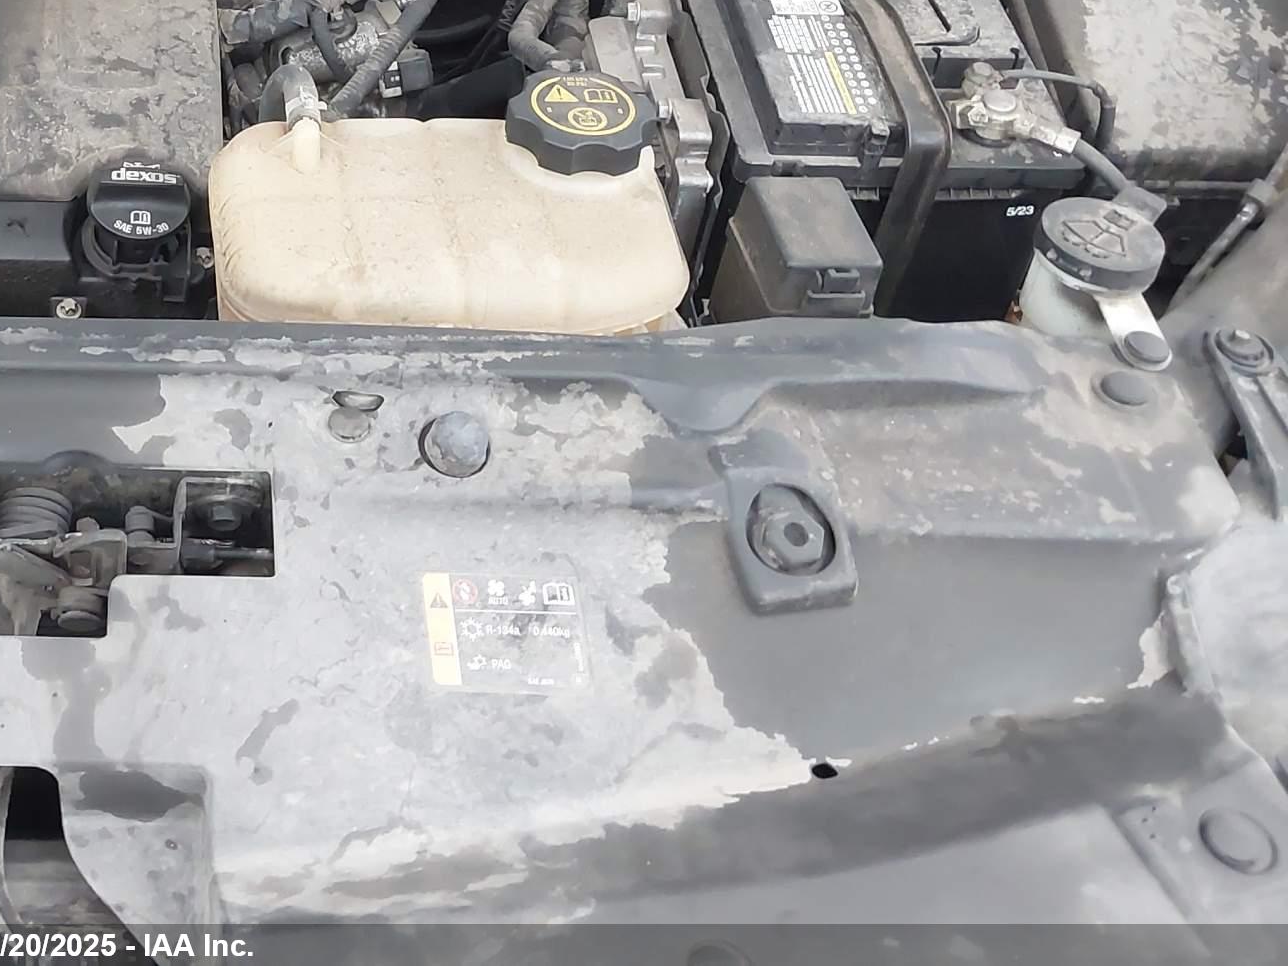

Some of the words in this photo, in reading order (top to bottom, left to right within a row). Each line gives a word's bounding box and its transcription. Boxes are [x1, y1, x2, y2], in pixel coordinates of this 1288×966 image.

[111, 168, 178, 185] dexos
[1006, 205, 1035, 217] 5/23
[114, 219, 133, 235] SAE
[136, 222, 170, 236] 5W-30
